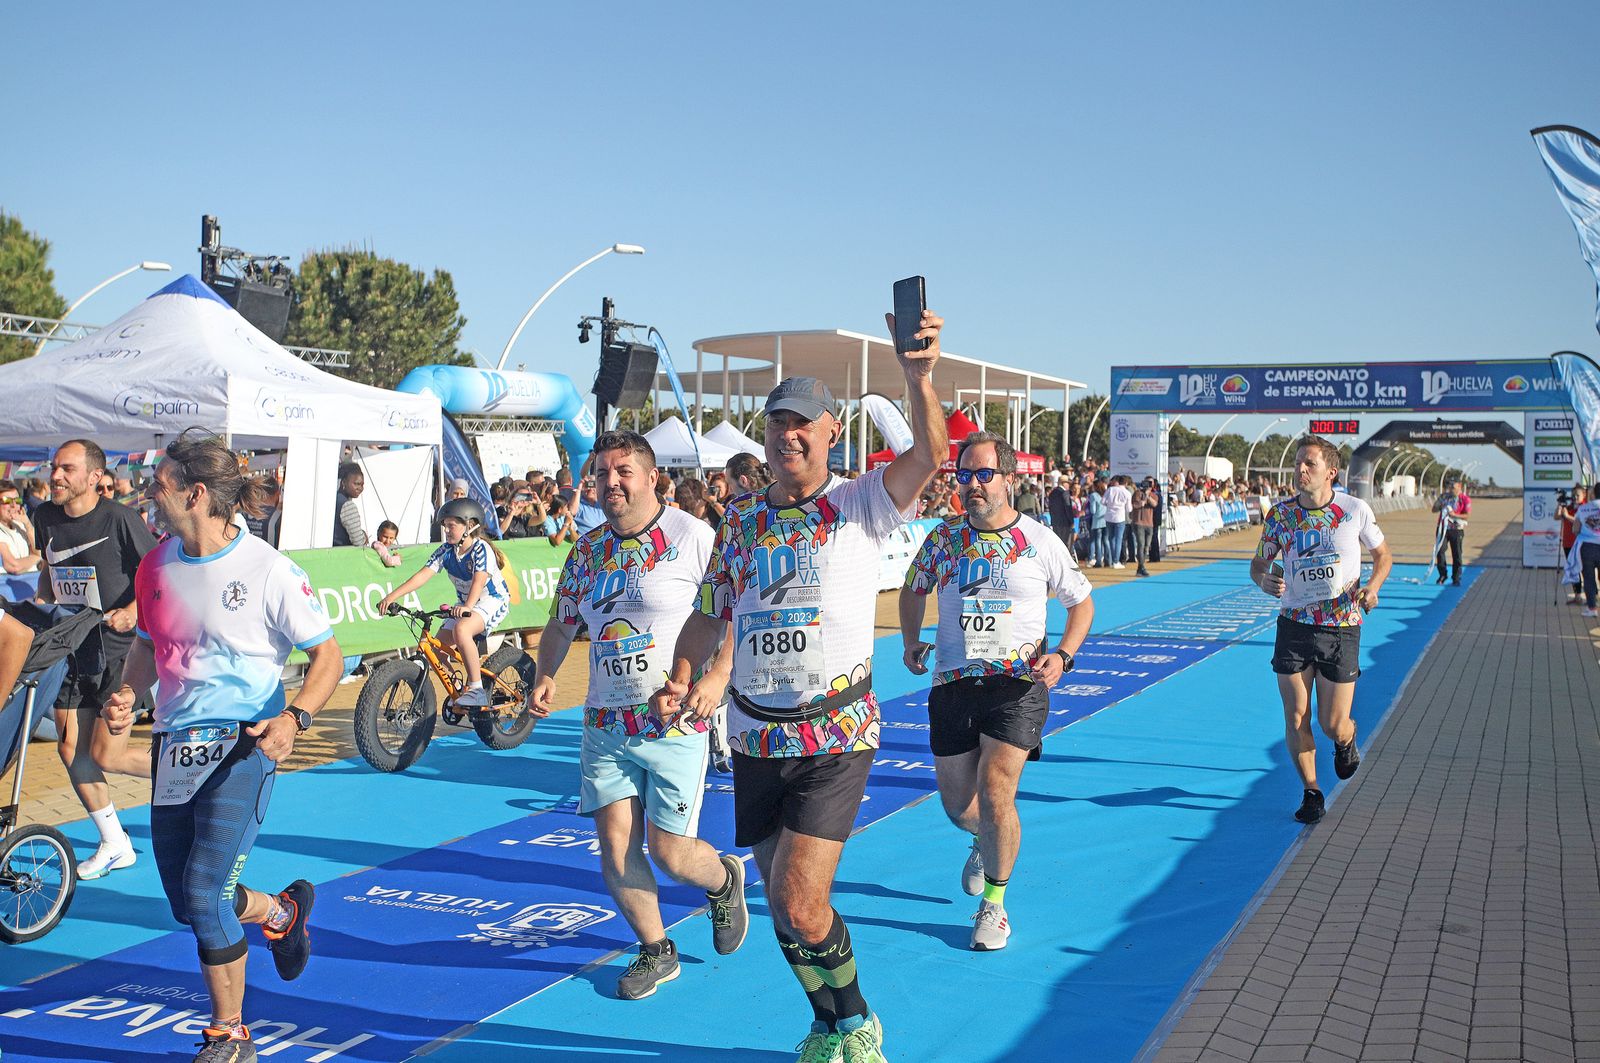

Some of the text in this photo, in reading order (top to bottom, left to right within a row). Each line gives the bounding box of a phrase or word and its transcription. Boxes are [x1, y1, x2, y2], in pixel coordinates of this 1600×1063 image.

[1264, 369, 1369, 382] CAMPEONATO
[1264, 381, 1407, 398] de ESPAÑA 10 km
[1449, 376, 1494, 391] HUELVA
[1532, 378, 1566, 391] WiH
[1332, 399, 1368, 407] Absoluto
[1370, 400, 1376, 408] y
[1300, 566, 1335, 582] 1590
[57, 582, 89, 597] 1037
[988, 603, 1007, 611] 2023
[787, 612, 813, 624] 2023
[627, 638, 649, 650] 2023
[749, 629, 807, 657] 1880
[603, 653, 649, 677] 1675
[169, 744, 225, 768] 1834
[343, 895, 489, 917] Ayuntamiento de
[365, 885, 515, 912] HUELVA
